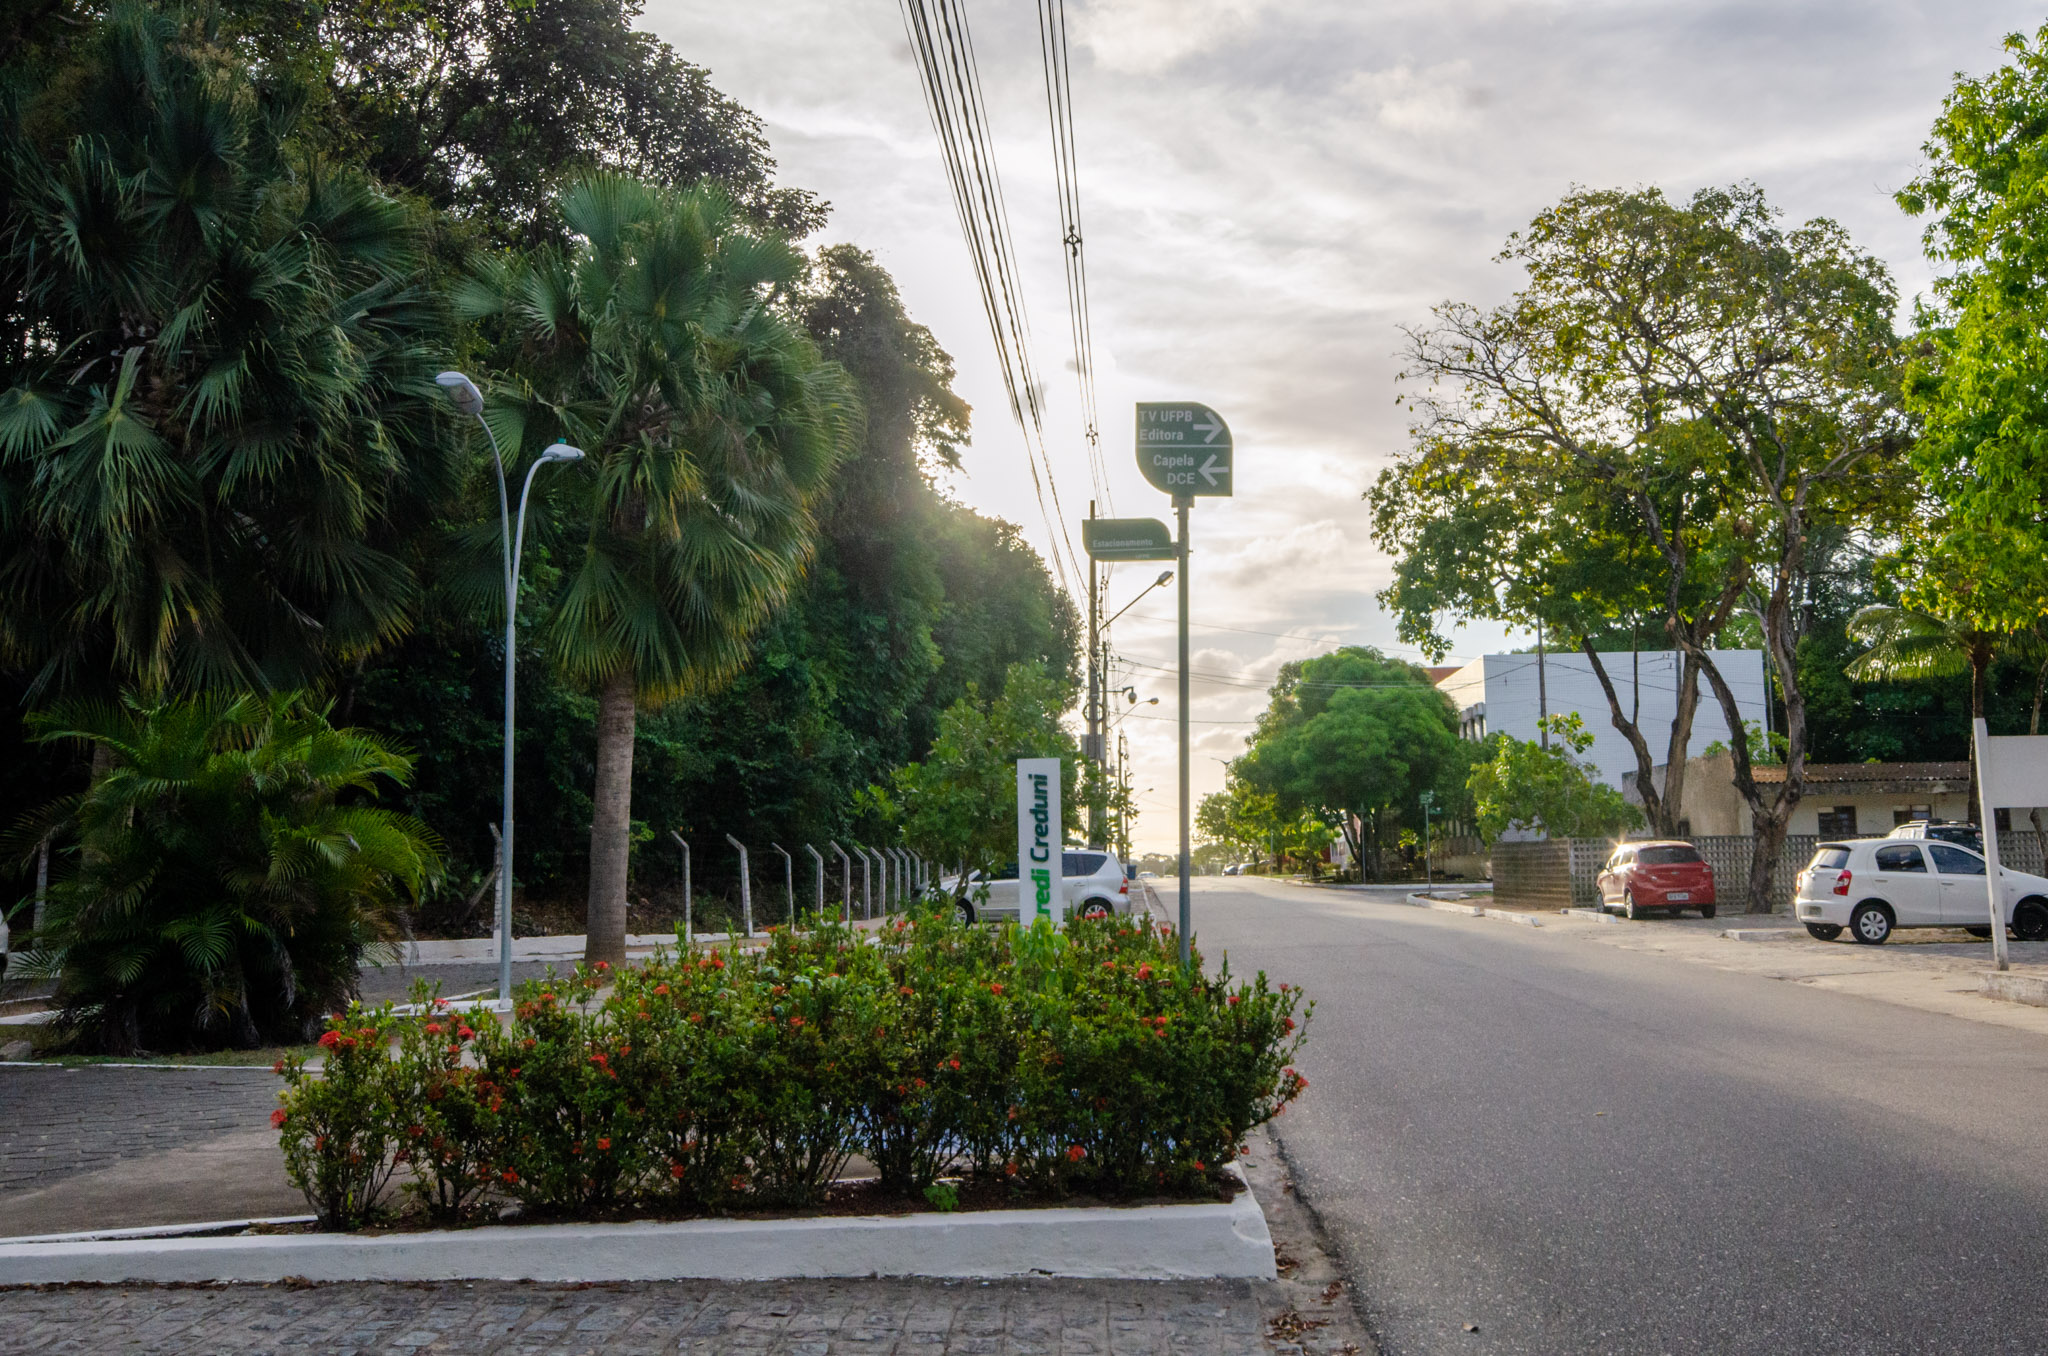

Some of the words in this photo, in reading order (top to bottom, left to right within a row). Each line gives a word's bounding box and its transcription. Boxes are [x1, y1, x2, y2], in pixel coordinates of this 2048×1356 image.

[1138, 410, 1157, 422] TV
[1160, 410, 1193, 422] UFPB
[1139, 428, 1184, 441] Editora
[1153, 453, 1194, 469] Capela
[1167, 472, 1195, 485] DCE
[1092, 538, 1153, 548] Estacionamento
[1028, 773, 1050, 863] Creduni
[1031, 868, 1051, 919] redi
